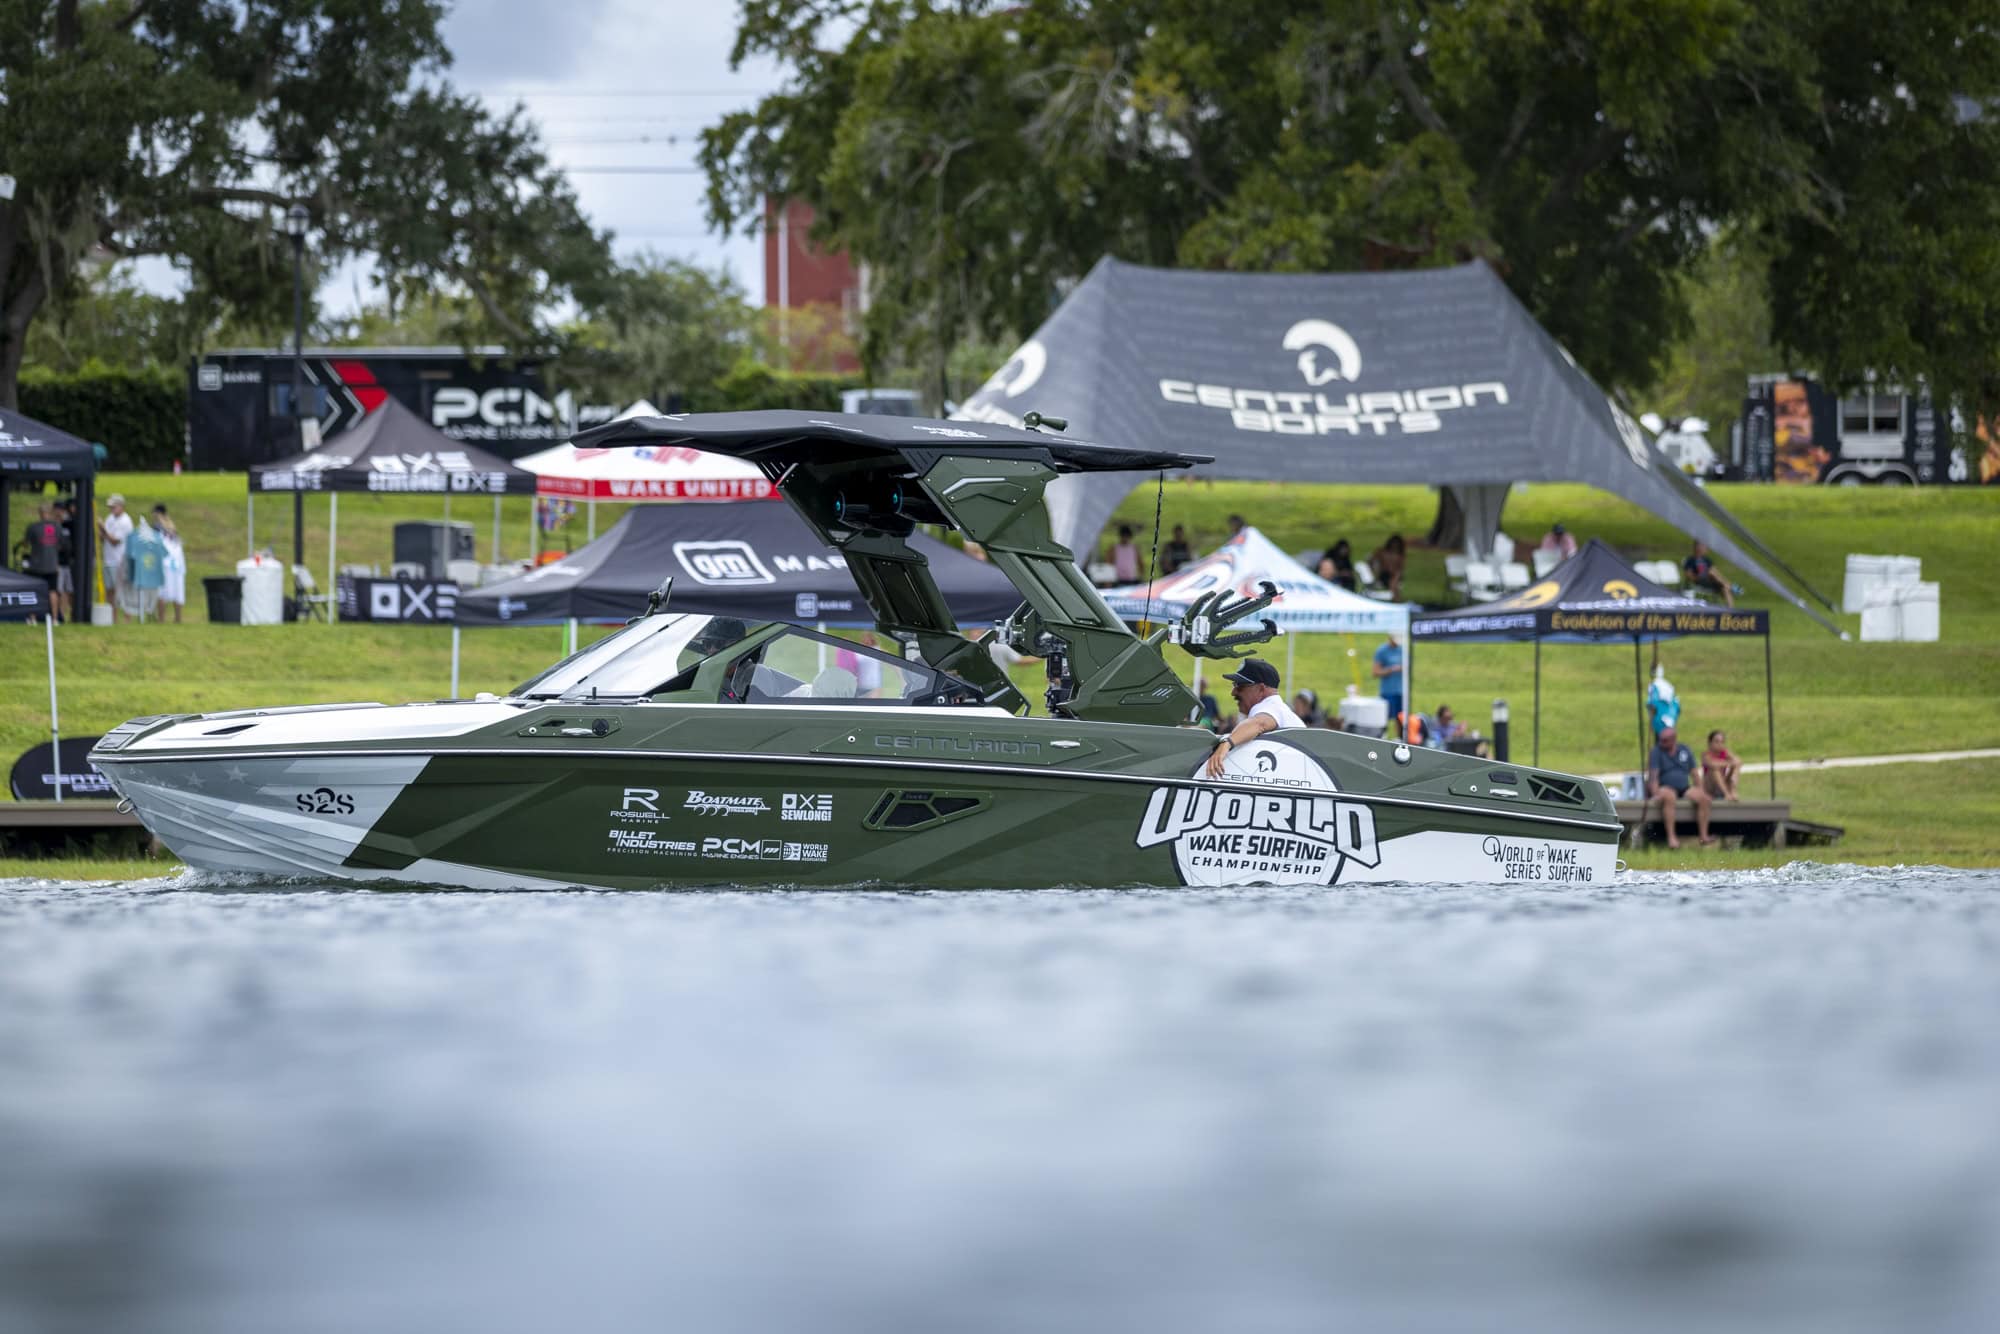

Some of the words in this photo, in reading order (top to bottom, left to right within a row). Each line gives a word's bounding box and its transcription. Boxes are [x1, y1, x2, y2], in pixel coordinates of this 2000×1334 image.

[1159, 378, 1508, 415] CENTURION
[432, 387, 573, 427] PCM
[1231, 409, 1441, 436] BOATS
[608, 480, 677, 496] WAKE
[683, 479, 772, 496] UNITED
[371, 583, 459, 619] OXE
[1551, 612, 1624, 630] Evolution
[1626, 613, 1644, 630] of
[1647, 613, 1671, 630] the
[1675, 613, 1715, 631] Wake
[1719, 613, 1757, 631] Boat
[874, 734, 1042, 755] CENTURION
[1221, 773, 1312, 788] CENTURION
[610, 810, 671, 819] ROSWELL
[608, 829, 656, 841] BILLET
[1135, 786, 1382, 870] WORLD
[607, 847, 650, 855] PRECISION
[653, 849, 698, 857] MACHINING
[616, 839, 697, 851] INDUSTRIES
[702, 837, 761, 854] PCM
[802, 850, 828, 858] WAKE
[1189, 834, 1244, 855] WAKE
[1246, 836, 1328, 862] SURFING
[1544, 843, 1578, 865] WAKE
[1190, 855, 1323, 876] CHAMPIONSHIP
